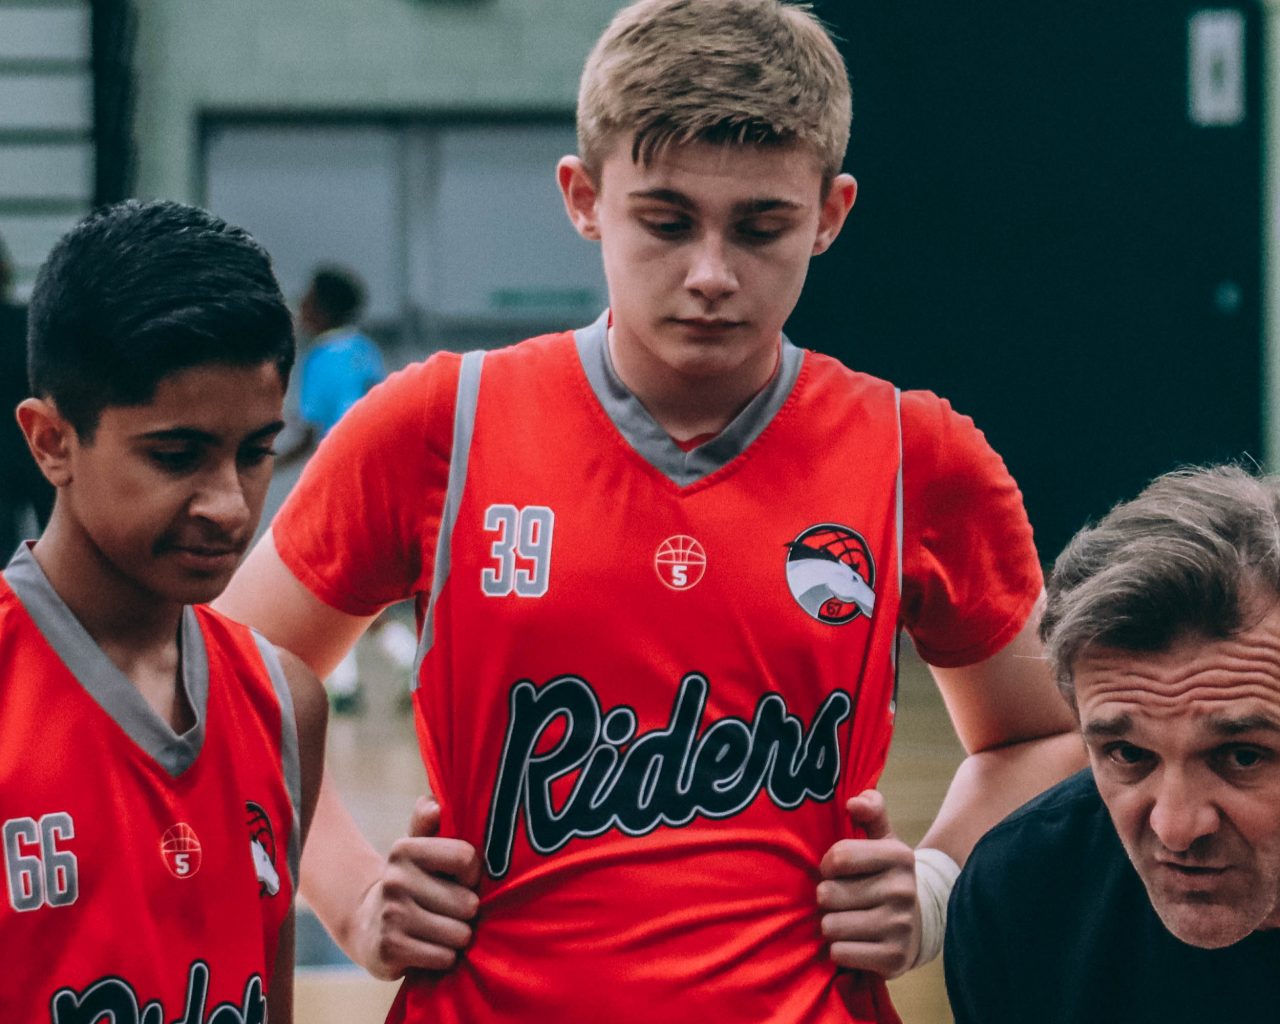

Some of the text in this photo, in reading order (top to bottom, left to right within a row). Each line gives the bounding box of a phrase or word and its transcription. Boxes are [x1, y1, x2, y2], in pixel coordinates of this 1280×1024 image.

[481, 504, 555, 598] 39
[672, 564, 688, 587] 5
[484, 671, 852, 880] Riders
[2, 811, 79, 912] 66
[174, 853, 190, 874] 5
